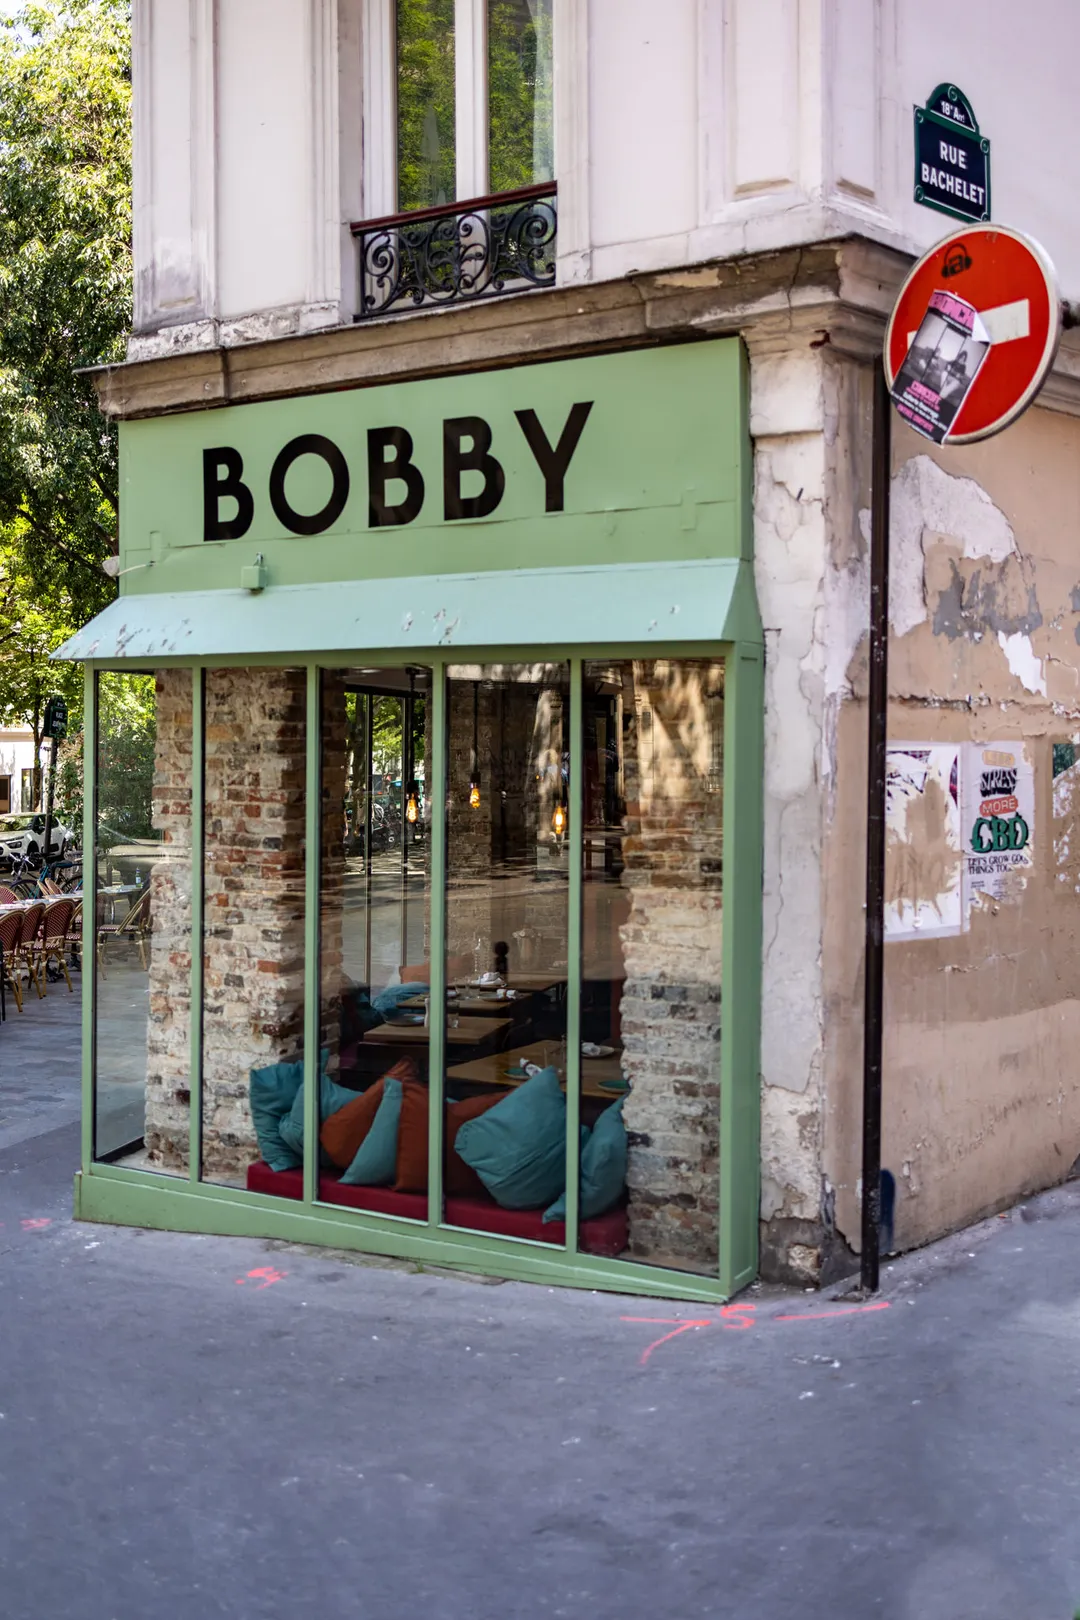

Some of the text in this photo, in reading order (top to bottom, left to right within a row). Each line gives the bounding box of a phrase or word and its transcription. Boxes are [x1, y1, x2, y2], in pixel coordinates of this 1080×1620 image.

[939, 140, 967, 170] RUE
[921, 162, 985, 206] BACHELET
[202, 400, 595, 542] BOBBY
[982, 798, 1016, 814] MORE
[970, 812, 1029, 853] CBD
[968, 864, 994, 875] THINGS
[988, 854, 1009, 865] GROW
